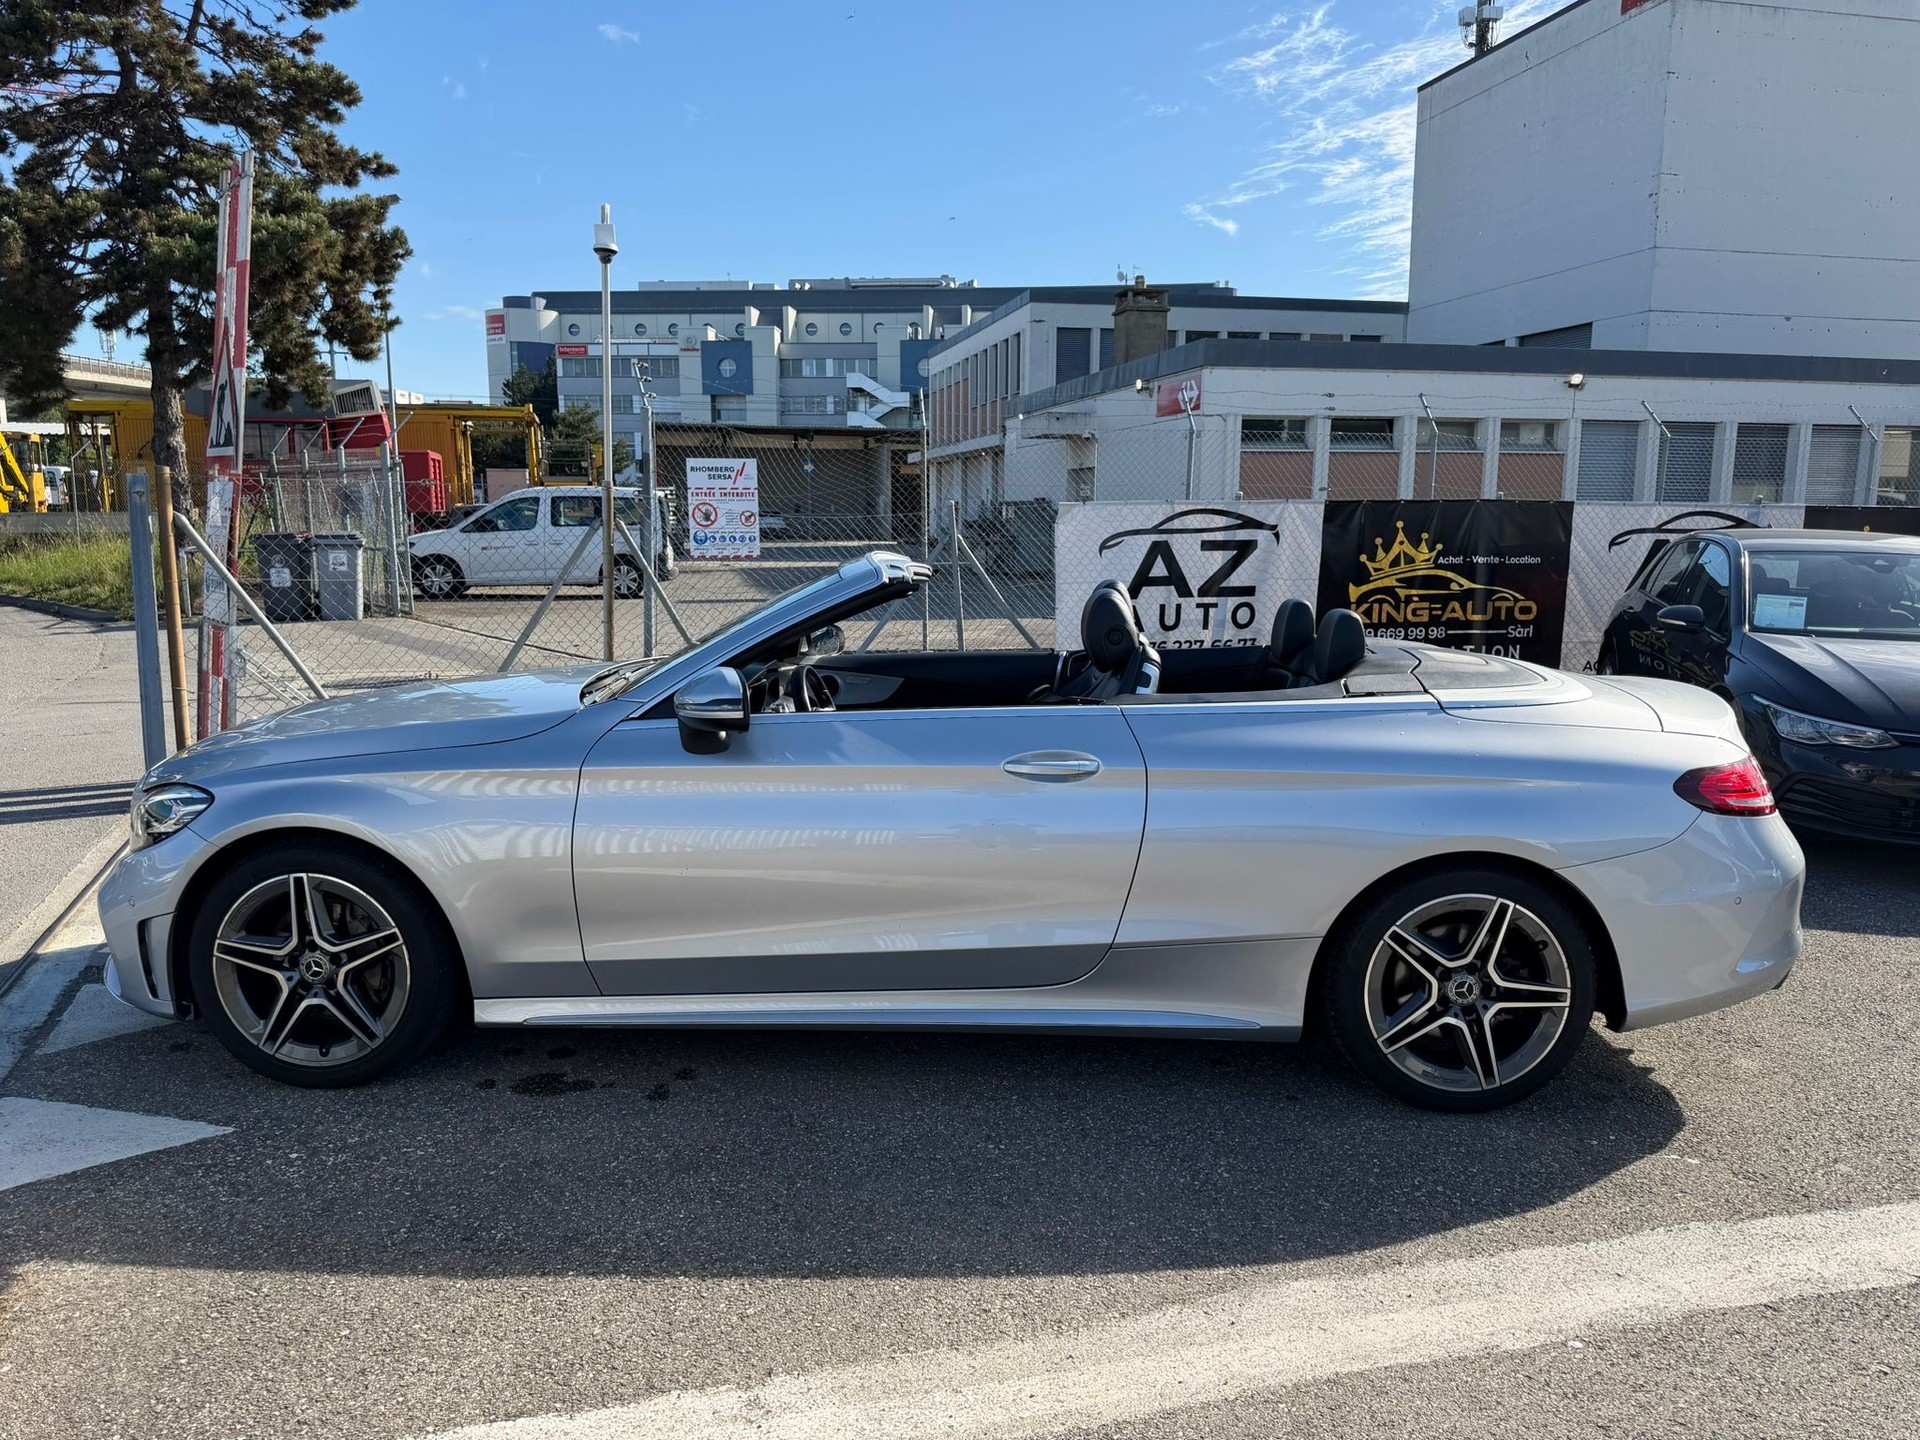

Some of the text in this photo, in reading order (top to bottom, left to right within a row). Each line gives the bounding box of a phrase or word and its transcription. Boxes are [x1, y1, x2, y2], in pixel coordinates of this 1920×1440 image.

[691, 490, 716, 498] ENTRÉE
[1437, 555, 1464, 564] Achat
[1472, 555, 1500, 564] Vente
[1505, 555, 1541, 564] Location
[1128, 539, 1259, 599] AZ
[1377, 628, 1405, 639] 669
[1408, 627, 1426, 639] 99
[1428, 626, 1446, 639] 98
[1507, 624, 1533, 638] Sàrl
